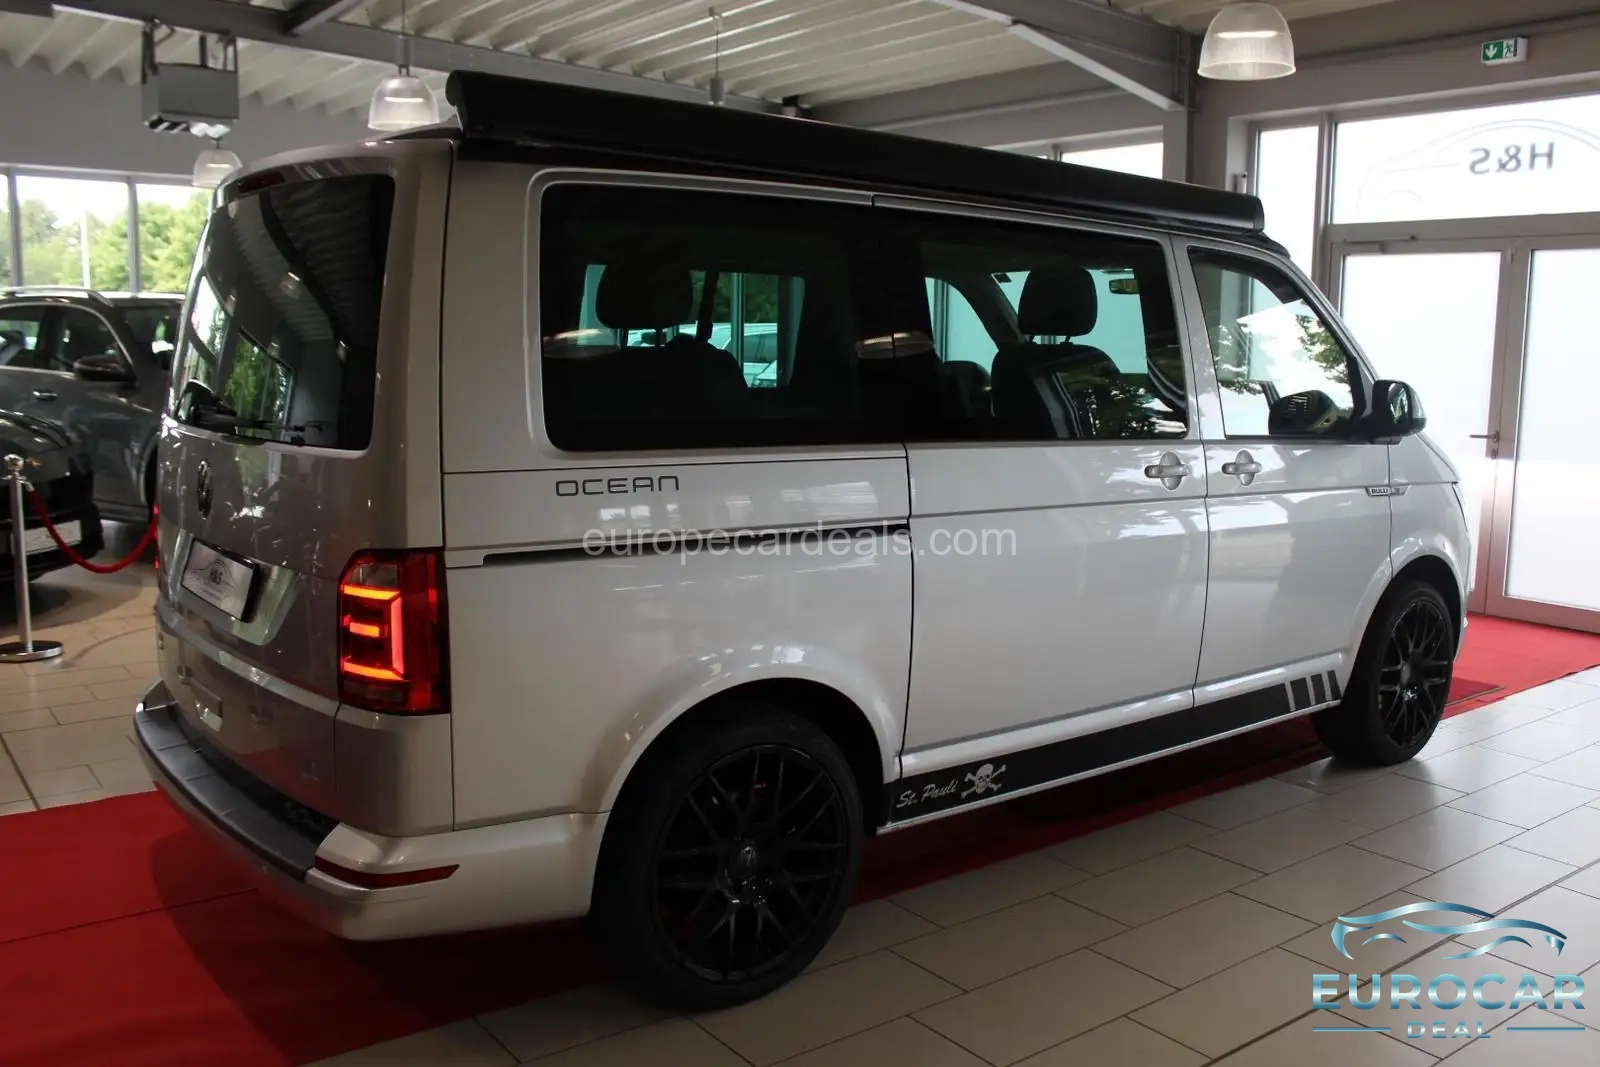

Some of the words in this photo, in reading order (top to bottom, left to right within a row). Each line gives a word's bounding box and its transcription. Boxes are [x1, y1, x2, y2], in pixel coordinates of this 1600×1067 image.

[555, 475, 680, 497] OCEAN
[896, 789, 919, 809] St.
[920, 779, 960, 803] Pauli
